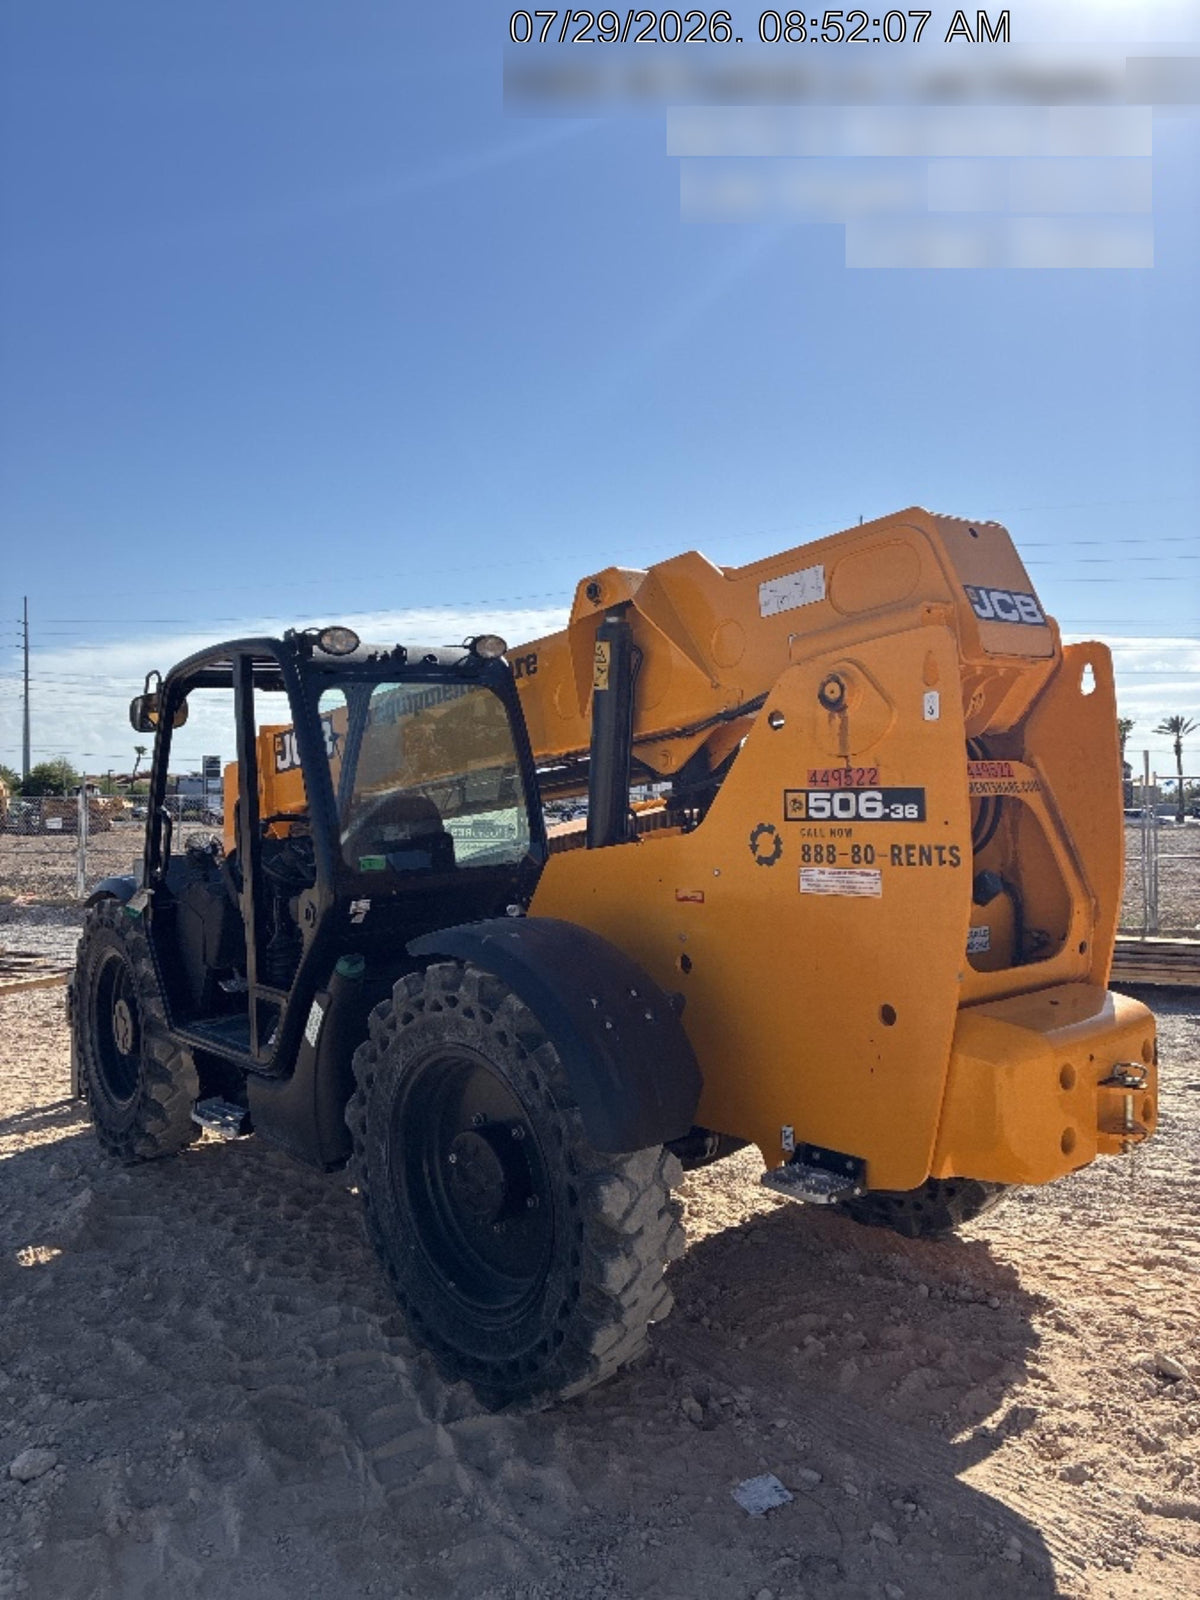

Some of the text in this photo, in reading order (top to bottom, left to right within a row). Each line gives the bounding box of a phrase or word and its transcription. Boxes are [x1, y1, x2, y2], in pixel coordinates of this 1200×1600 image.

[972, 588, 1046, 624] JCB
[808, 767, 878, 787] 449522
[808, 790, 919, 819] 506-36
[800, 827, 853, 839] CALL NOW
[801, 843, 962, 868] 888-80-RENTS
